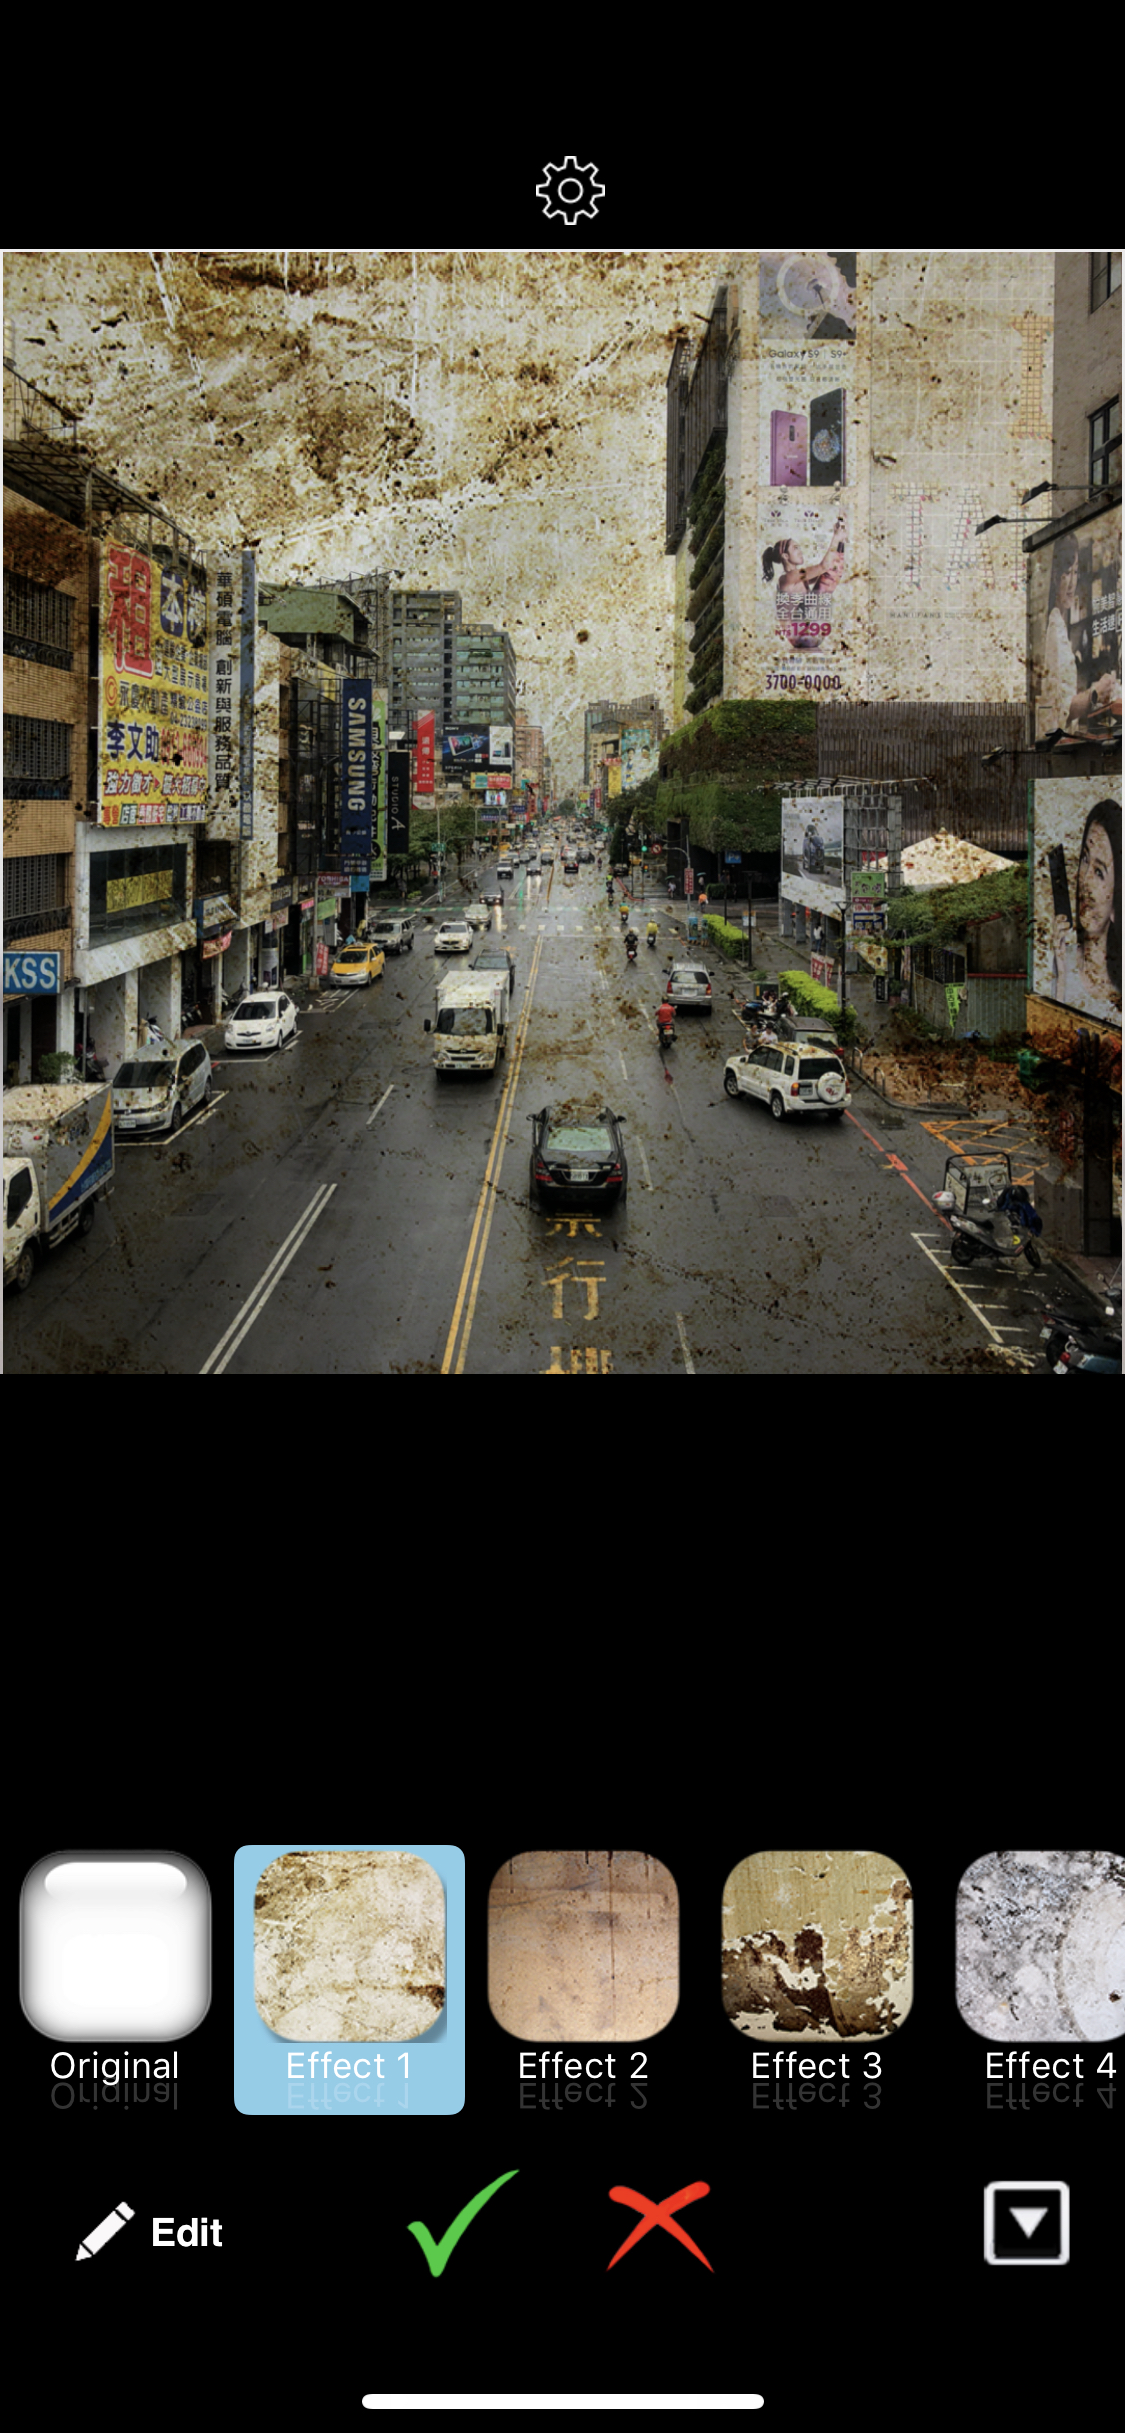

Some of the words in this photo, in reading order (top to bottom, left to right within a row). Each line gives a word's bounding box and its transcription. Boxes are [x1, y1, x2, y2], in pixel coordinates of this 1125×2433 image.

[768, 349, 806, 361] Galaxy
[808, 349, 819, 358] S9
[216, 572, 233, 646] 華碩電腦
[776, 593, 832, 606] 換季曲線
[776, 607, 832, 620] 全台通用
[765, 674, 841, 690] 3700-0000
[215, 659, 233, 790] 創新與服務品質
[347, 697, 367, 812] SAMSUNG
[391, 776, 400, 815] STUDIO
[4, 957, 56, 989] KSS
[51, 2051, 178, 2086] Original
[287, 2051, 385, 2079] Effect
[397, 2051, 409, 2079] 1
[519, 2051, 616, 2079] Effect
[630, 2051, 648, 2079] 2
[752, 2051, 850, 2079] Effect
[863, 2051, 882, 2079] 3
[986, 2051, 1084, 2079] Effect
[1096, 2051, 1117, 2079] 4
[152, 2217, 223, 2247] Edit
